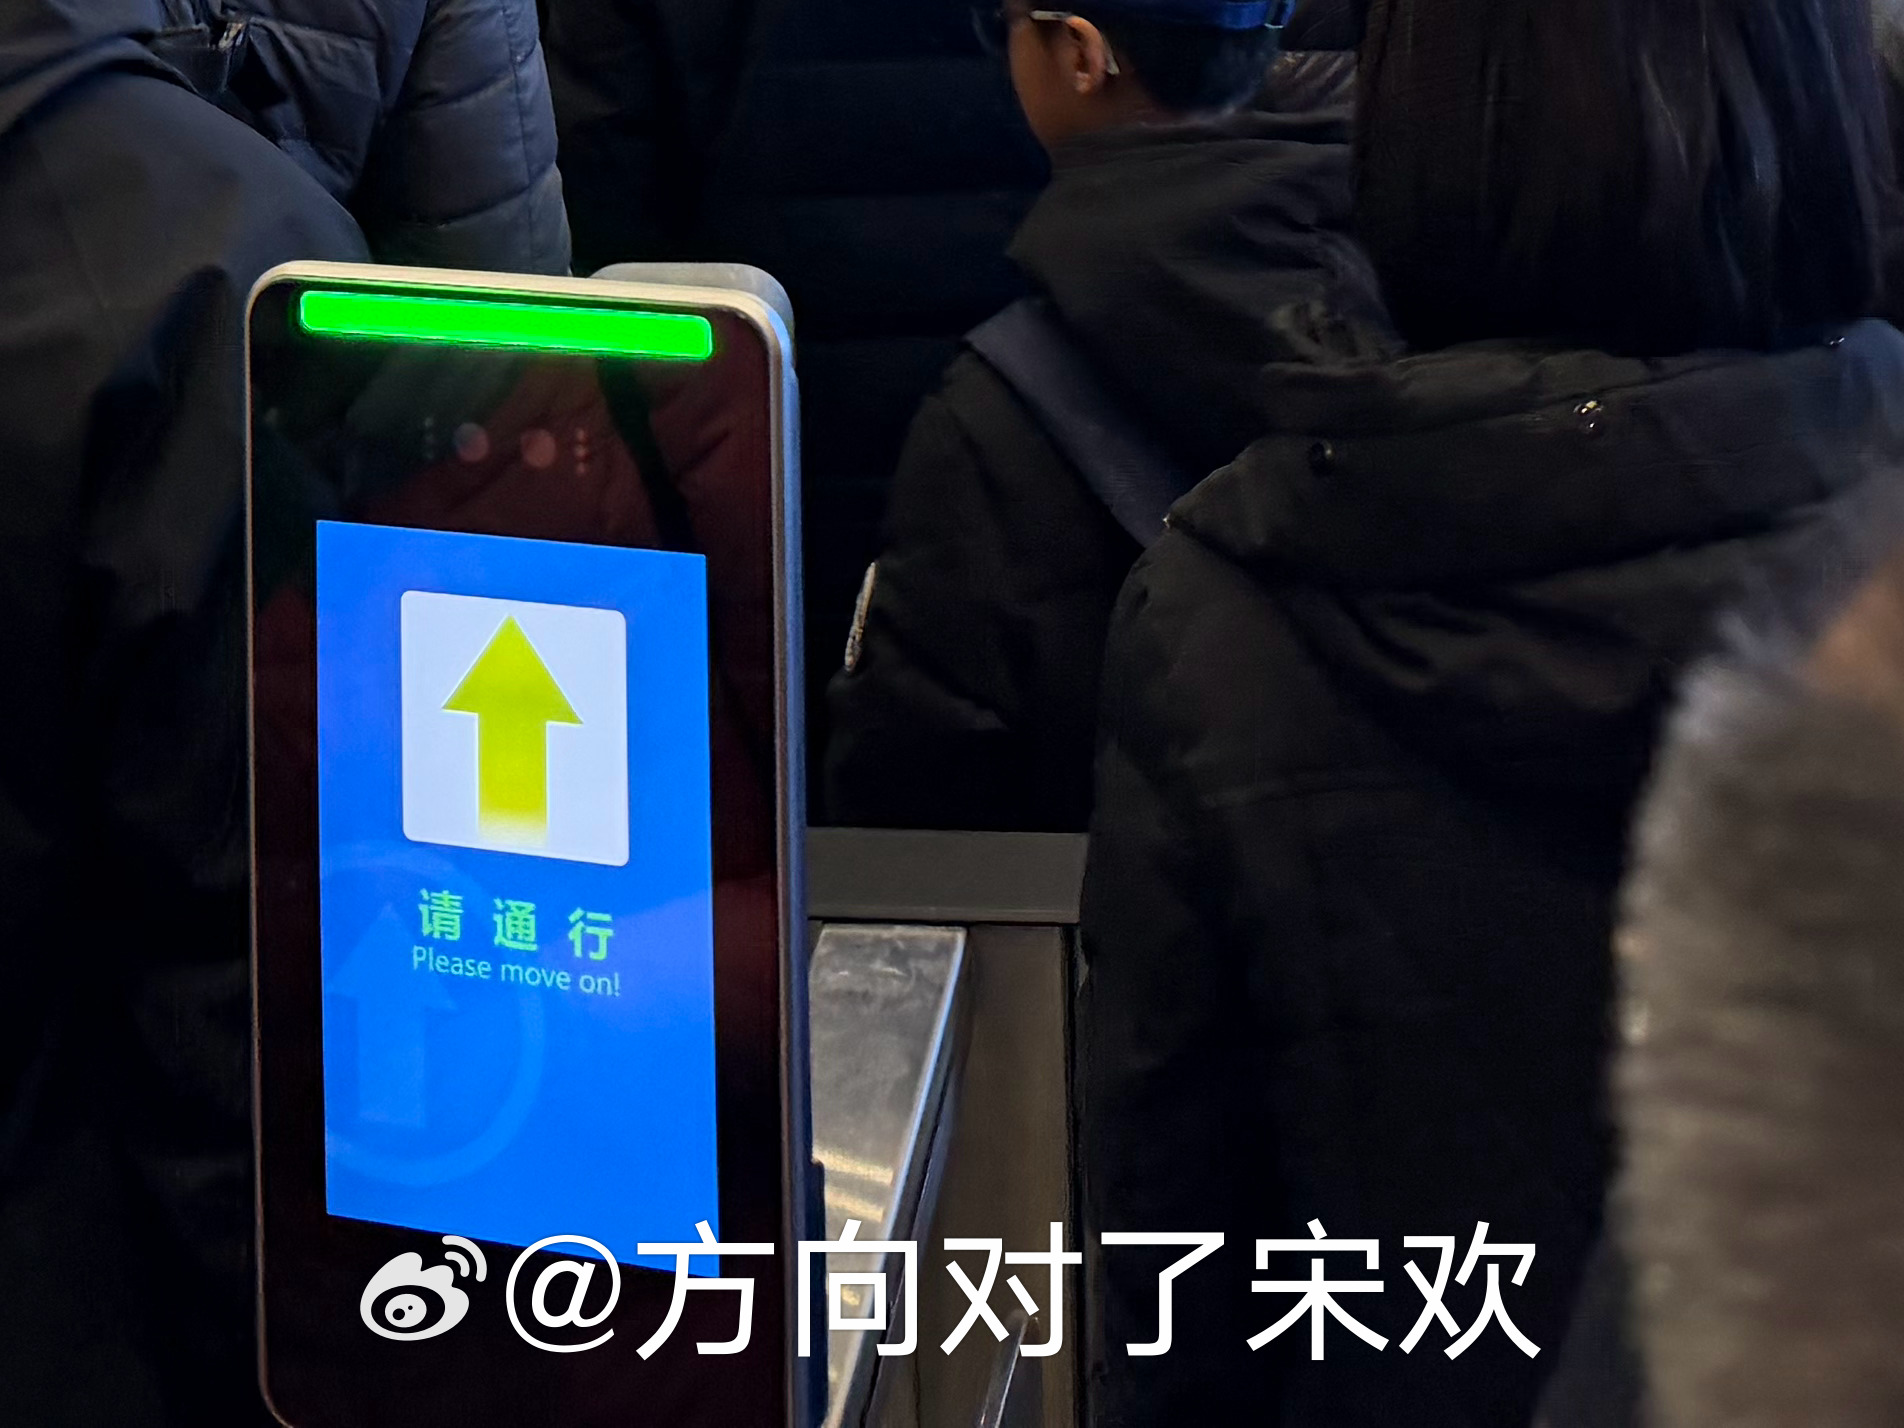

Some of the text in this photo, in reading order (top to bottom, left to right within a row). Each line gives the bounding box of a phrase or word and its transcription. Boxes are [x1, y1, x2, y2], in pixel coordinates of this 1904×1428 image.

[418, 888, 615, 962] 请通行
[412, 945, 621, 997] Please move on!
